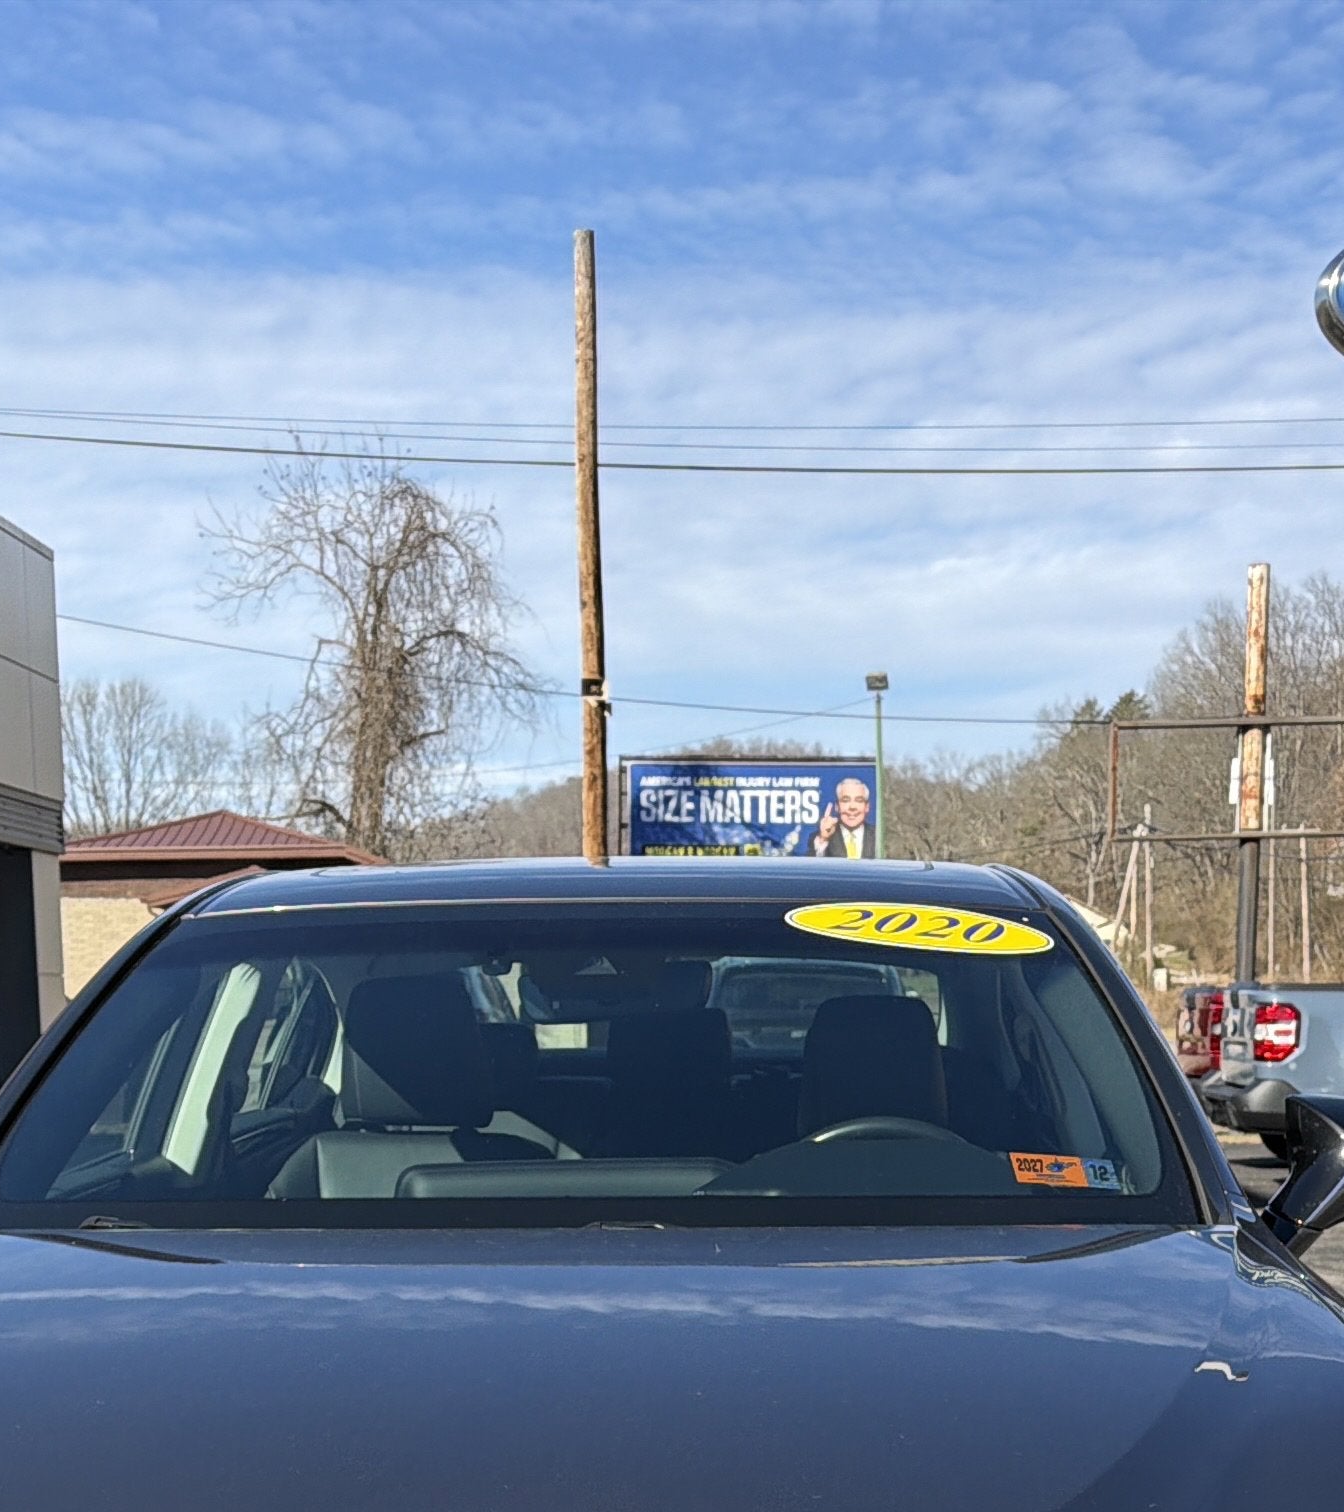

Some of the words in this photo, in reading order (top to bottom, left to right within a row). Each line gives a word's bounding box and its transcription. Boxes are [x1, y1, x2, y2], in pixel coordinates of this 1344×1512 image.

[639, 789, 695, 823] SIZE
[699, 789, 820, 825] MATTERS
[828, 908, 1007, 944] 2020
[1015, 1157, 1044, 1173] 2027
[1088, 1164, 1110, 1182] 12
